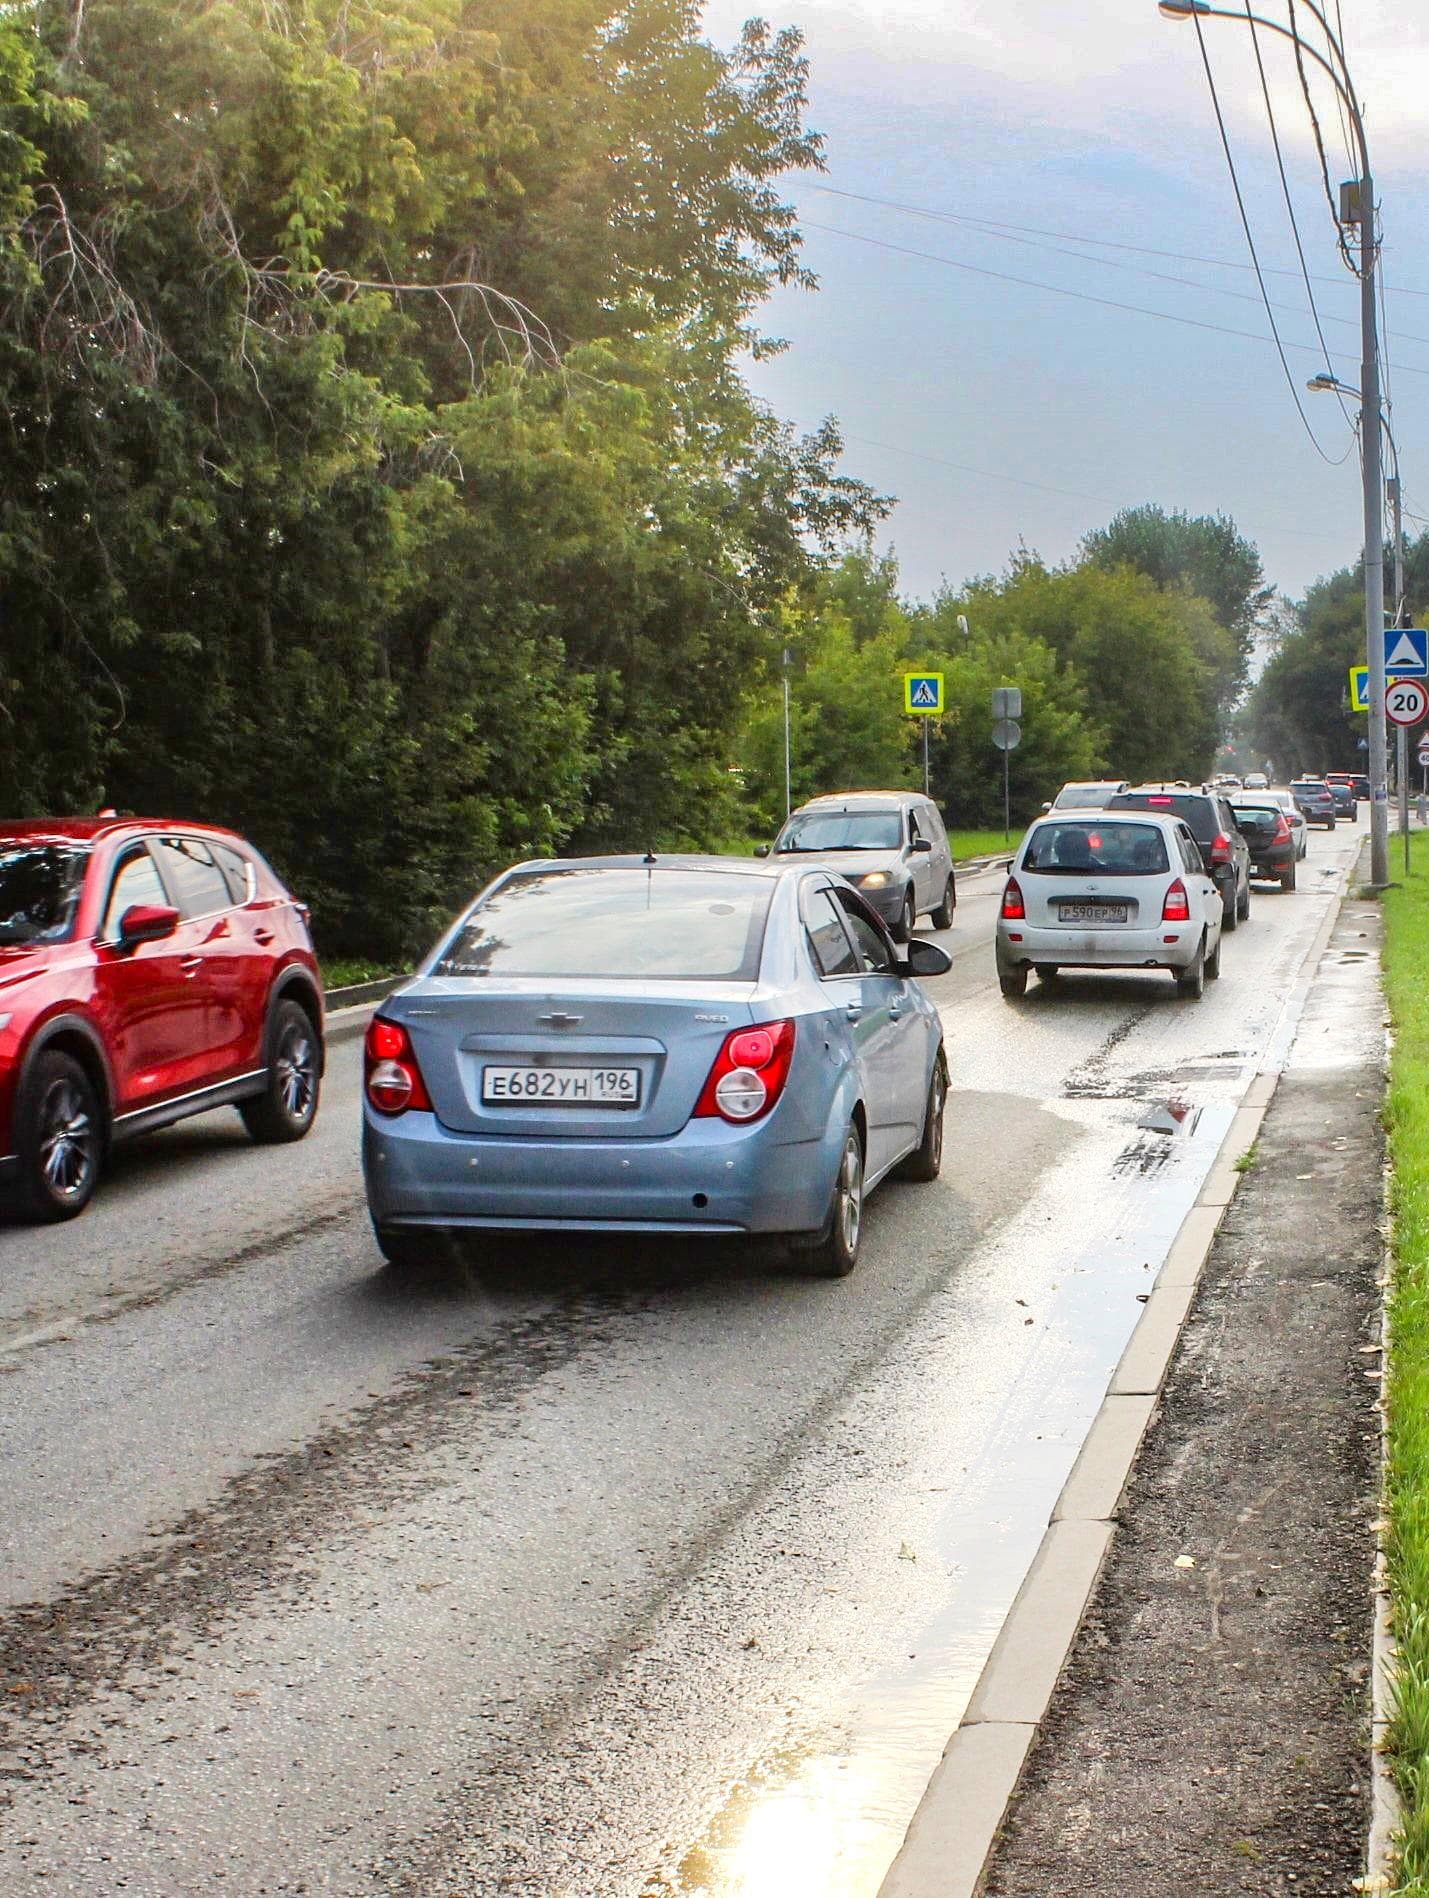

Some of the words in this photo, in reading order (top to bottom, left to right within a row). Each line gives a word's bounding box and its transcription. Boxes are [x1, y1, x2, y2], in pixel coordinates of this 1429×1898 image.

[1393, 694, 1418, 712] 20
[493, 1072, 588, 1096] Е682УН
[594, 1072, 631, 1091] 196
